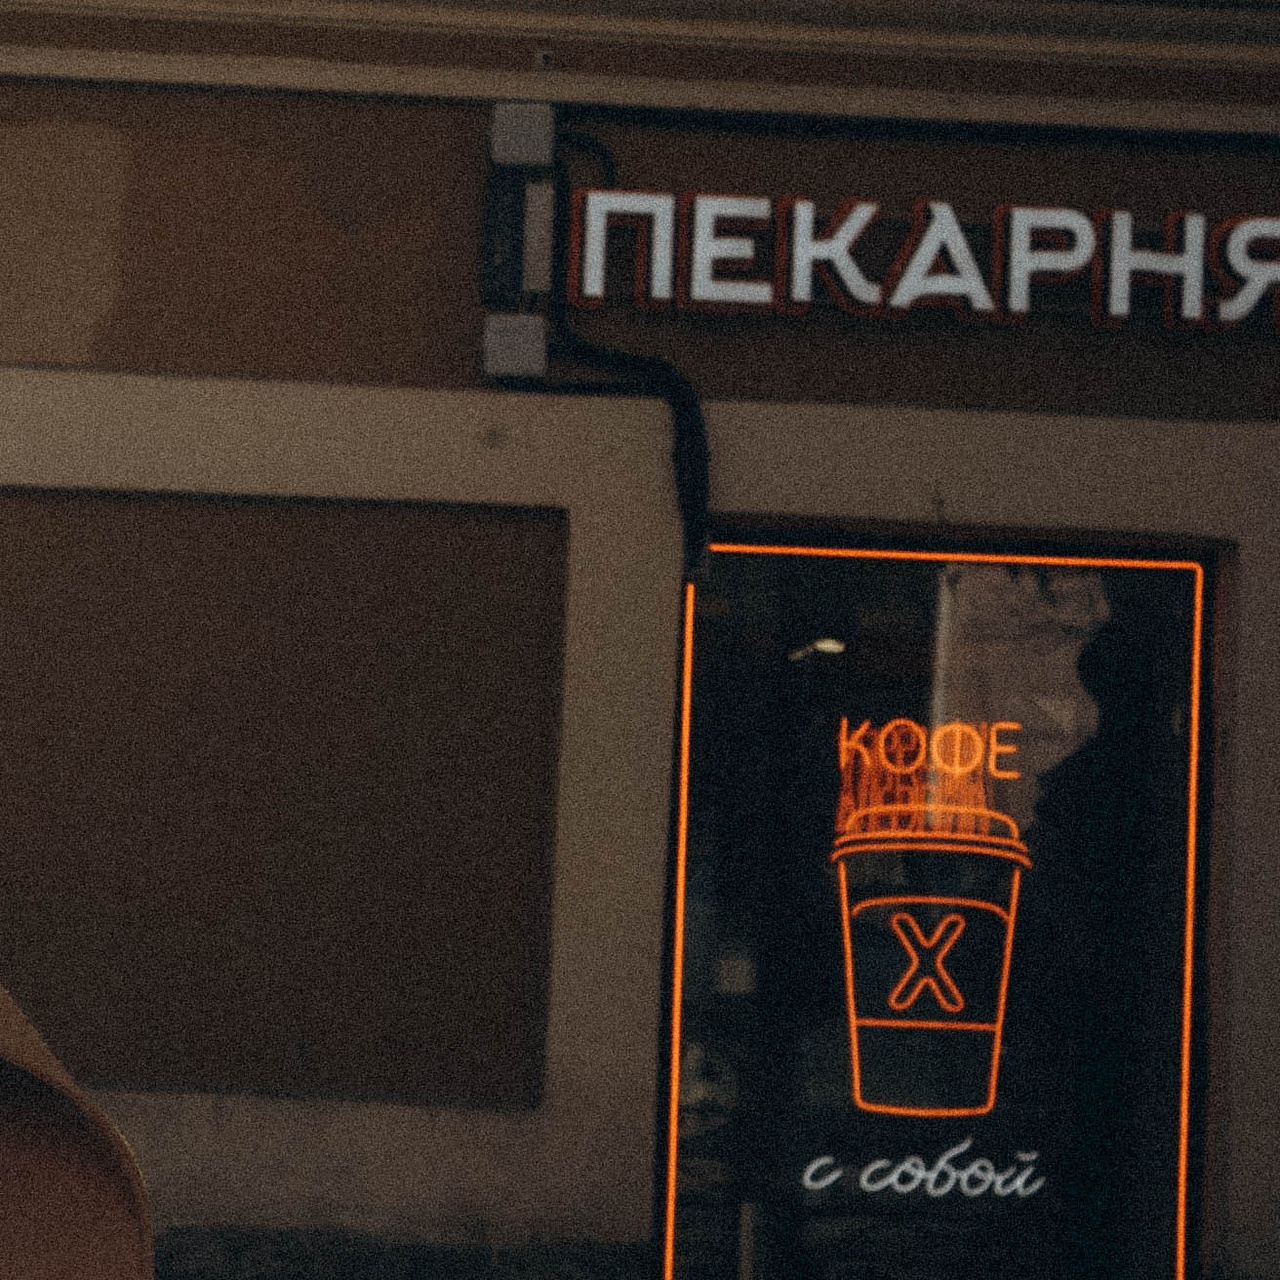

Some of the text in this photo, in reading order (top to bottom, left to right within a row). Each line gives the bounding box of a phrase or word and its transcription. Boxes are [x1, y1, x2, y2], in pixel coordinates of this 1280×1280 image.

[580, 190, 1280, 322] ПЕКАРНЯ
[837, 716, 1023, 781] КОФЕ
[858, 1136, 1049, 1199] собой
